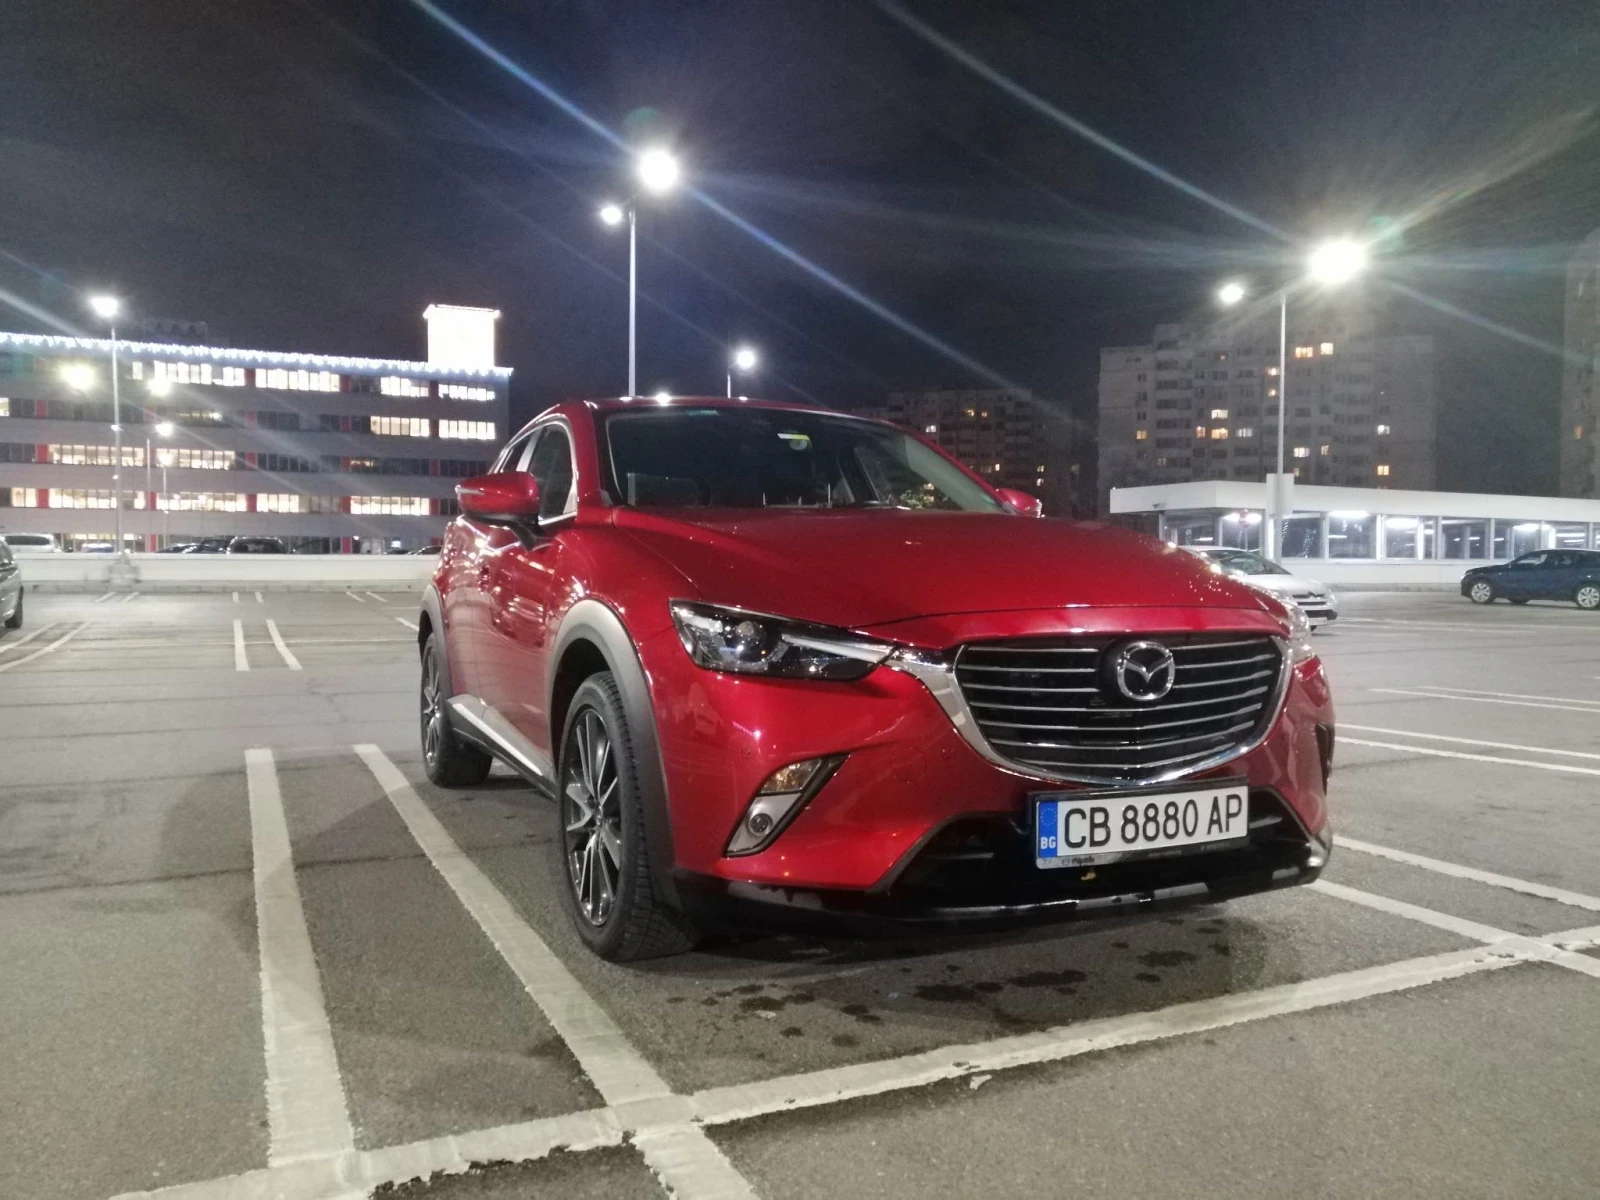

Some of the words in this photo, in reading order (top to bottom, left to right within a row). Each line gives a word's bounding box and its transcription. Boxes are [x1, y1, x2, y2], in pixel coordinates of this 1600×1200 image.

[1064, 807, 1111, 848] CB
[1121, 799, 1198, 844] 8880
[1207, 794, 1242, 836] AP
[1040, 837, 1056, 850] BG
